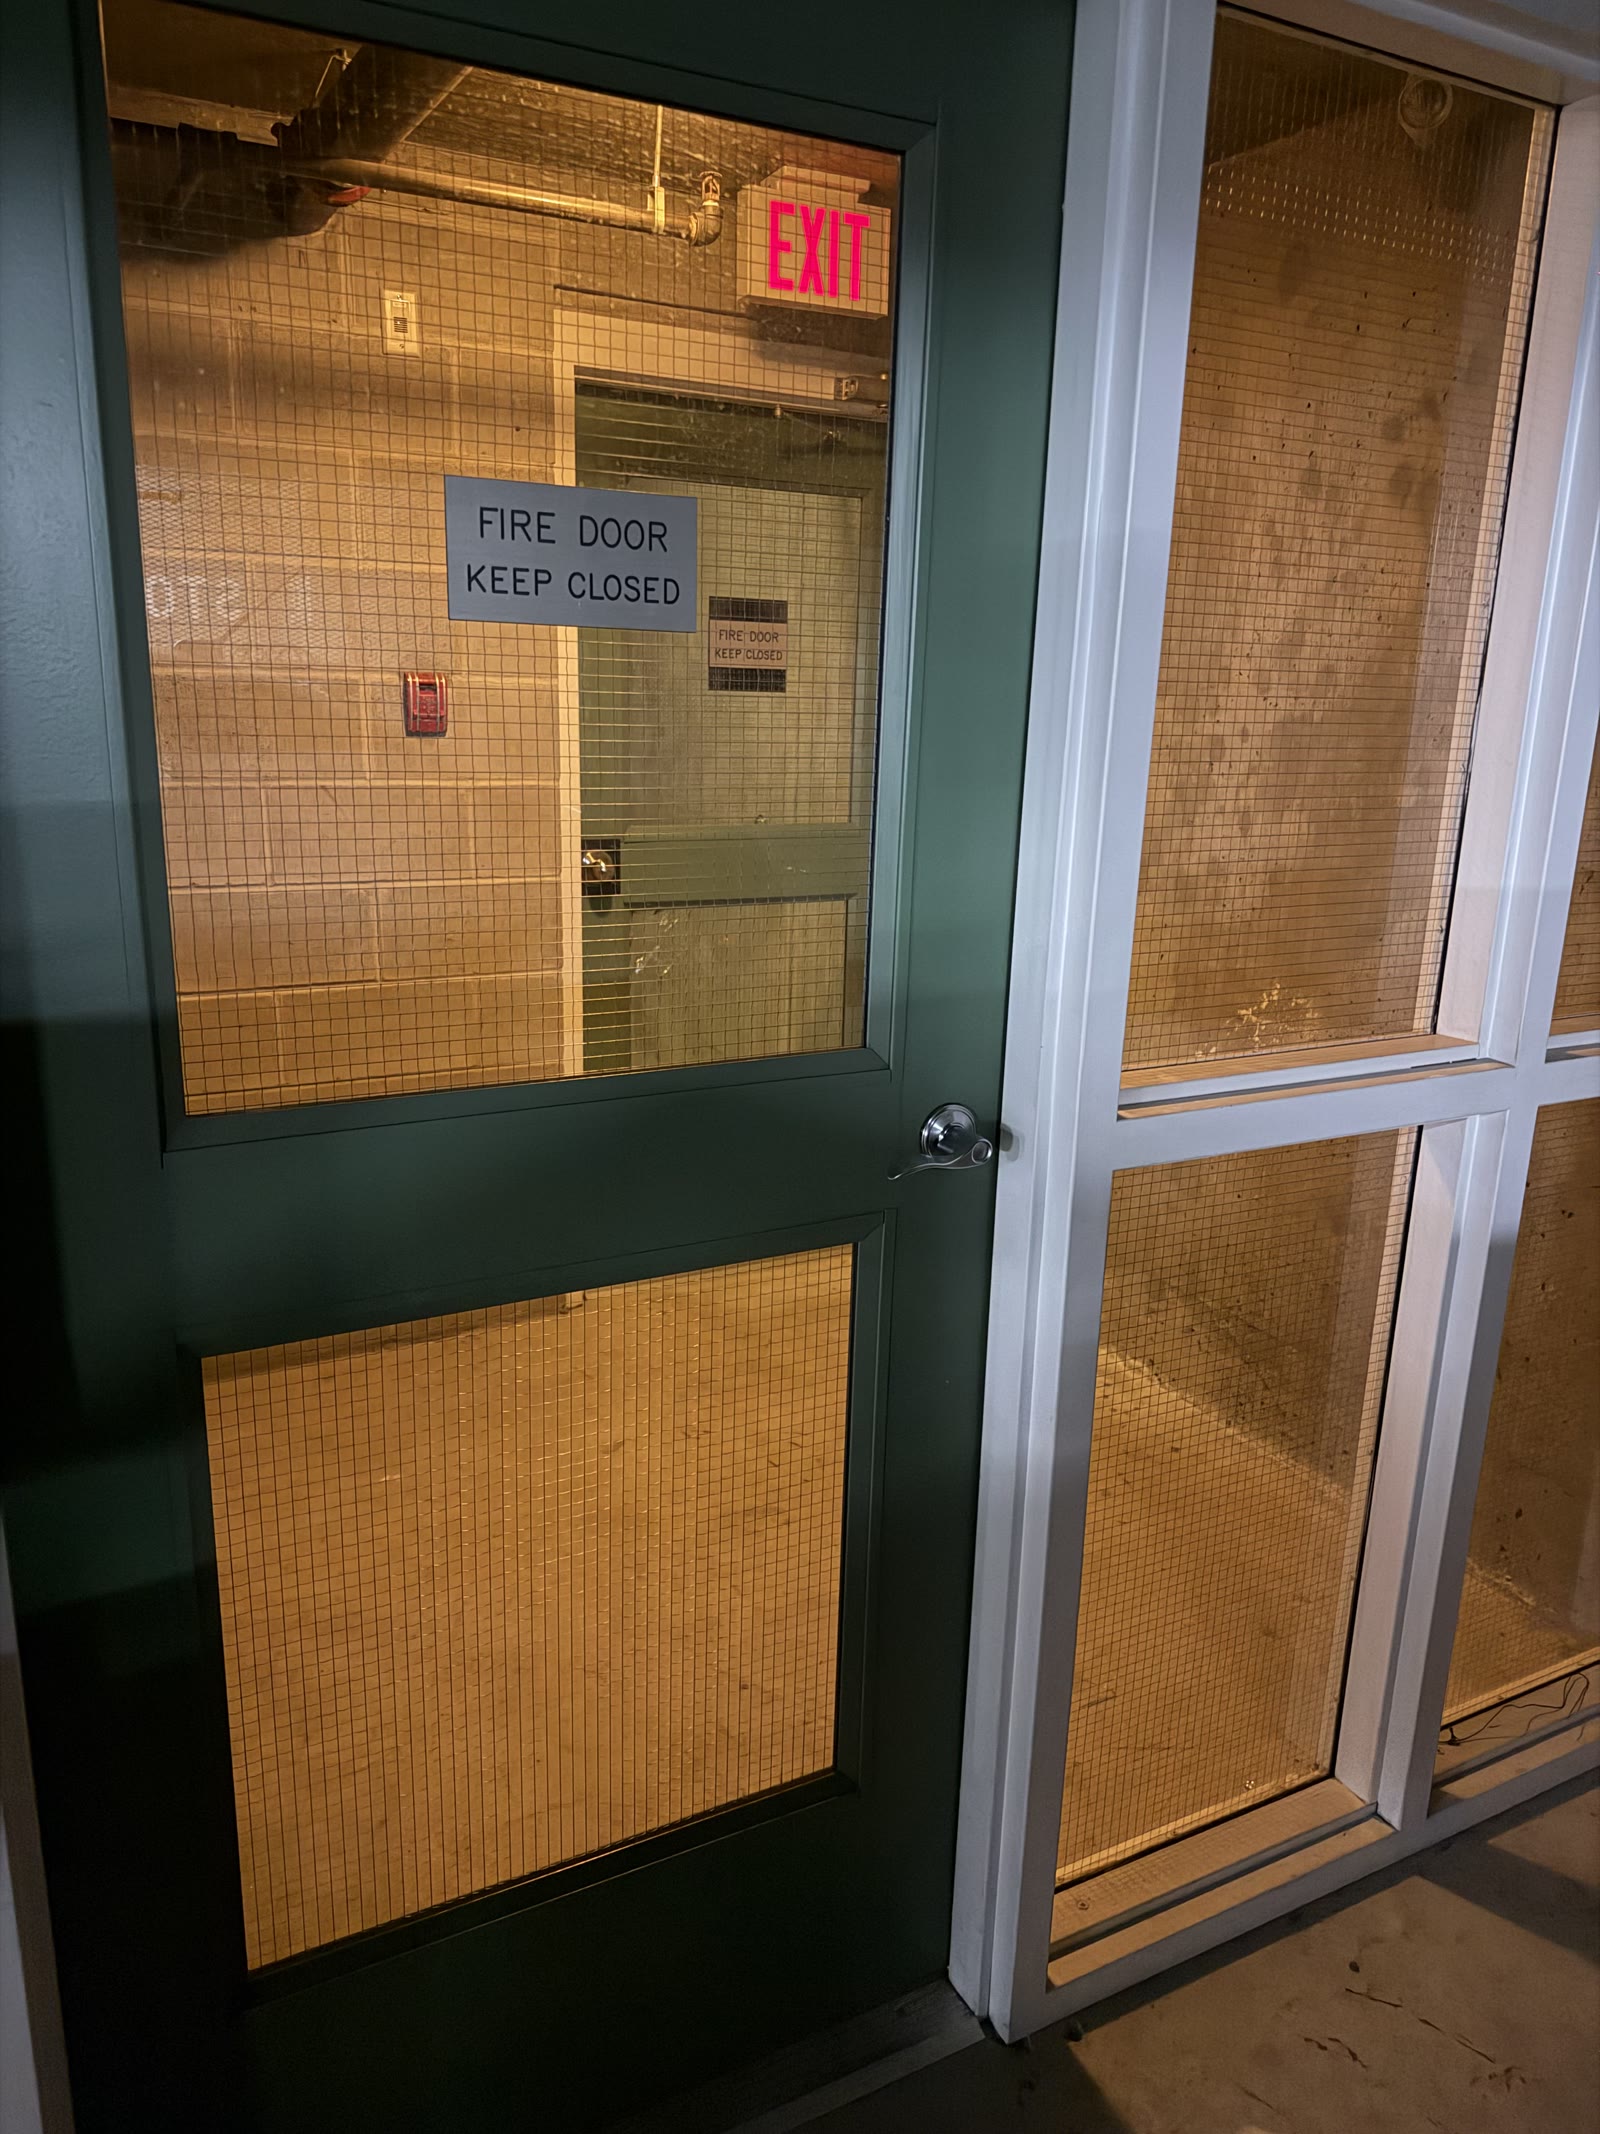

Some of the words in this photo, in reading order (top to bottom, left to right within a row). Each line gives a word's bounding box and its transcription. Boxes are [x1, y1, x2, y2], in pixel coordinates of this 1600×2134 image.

[769, 200, 871, 302] EXIT
[479, 506, 556, 544] FIRE
[579, 515, 668, 552] DOOR
[466, 563, 552, 596] KEEP
[567, 572, 680, 605] CLOSED
[714, 648, 742, 659] KEEP
[745, 649, 783, 661] CLOSED
[719, 629, 743, 642] FIRE
[749, 630, 779, 643] DOOR
